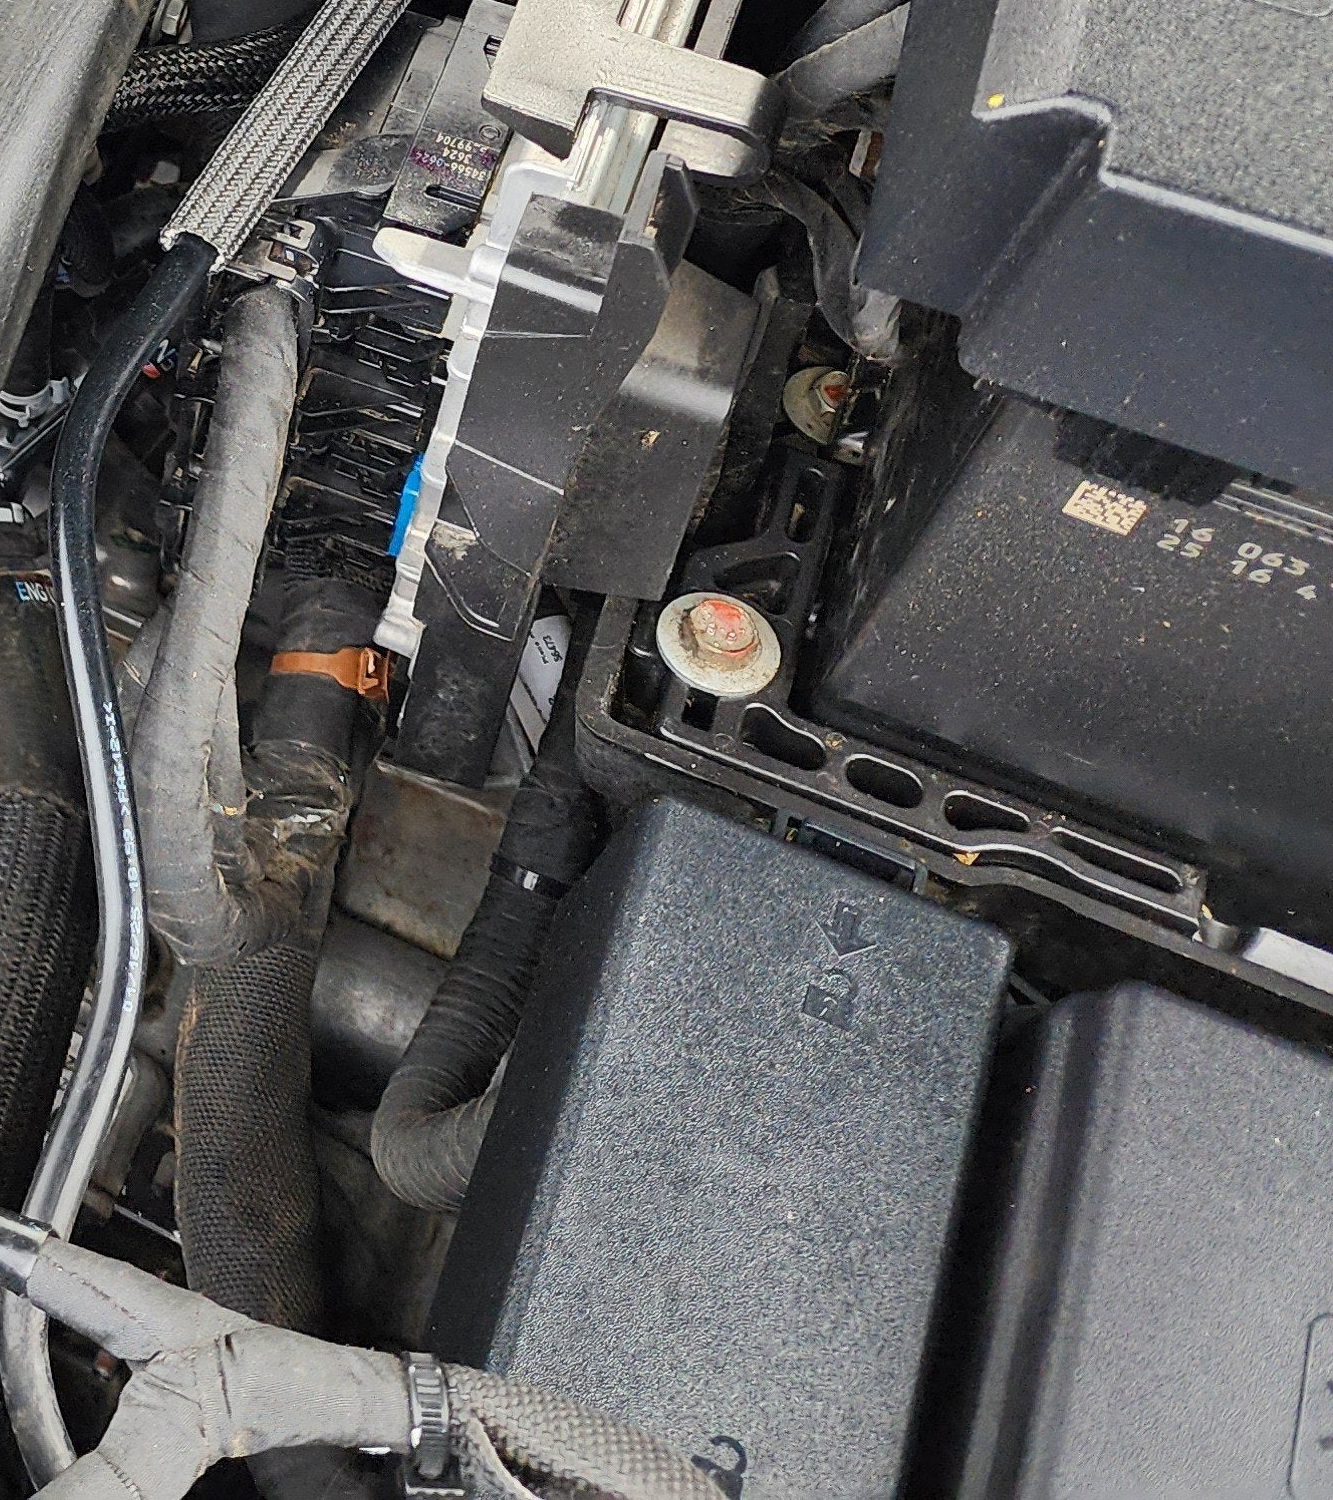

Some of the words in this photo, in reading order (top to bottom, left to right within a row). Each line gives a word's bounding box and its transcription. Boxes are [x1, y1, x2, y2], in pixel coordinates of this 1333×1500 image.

[1174, 518, 1215, 542] 16
[1156, 534, 1203, 558] 25
[1231, 560, 1274, 583] 16
